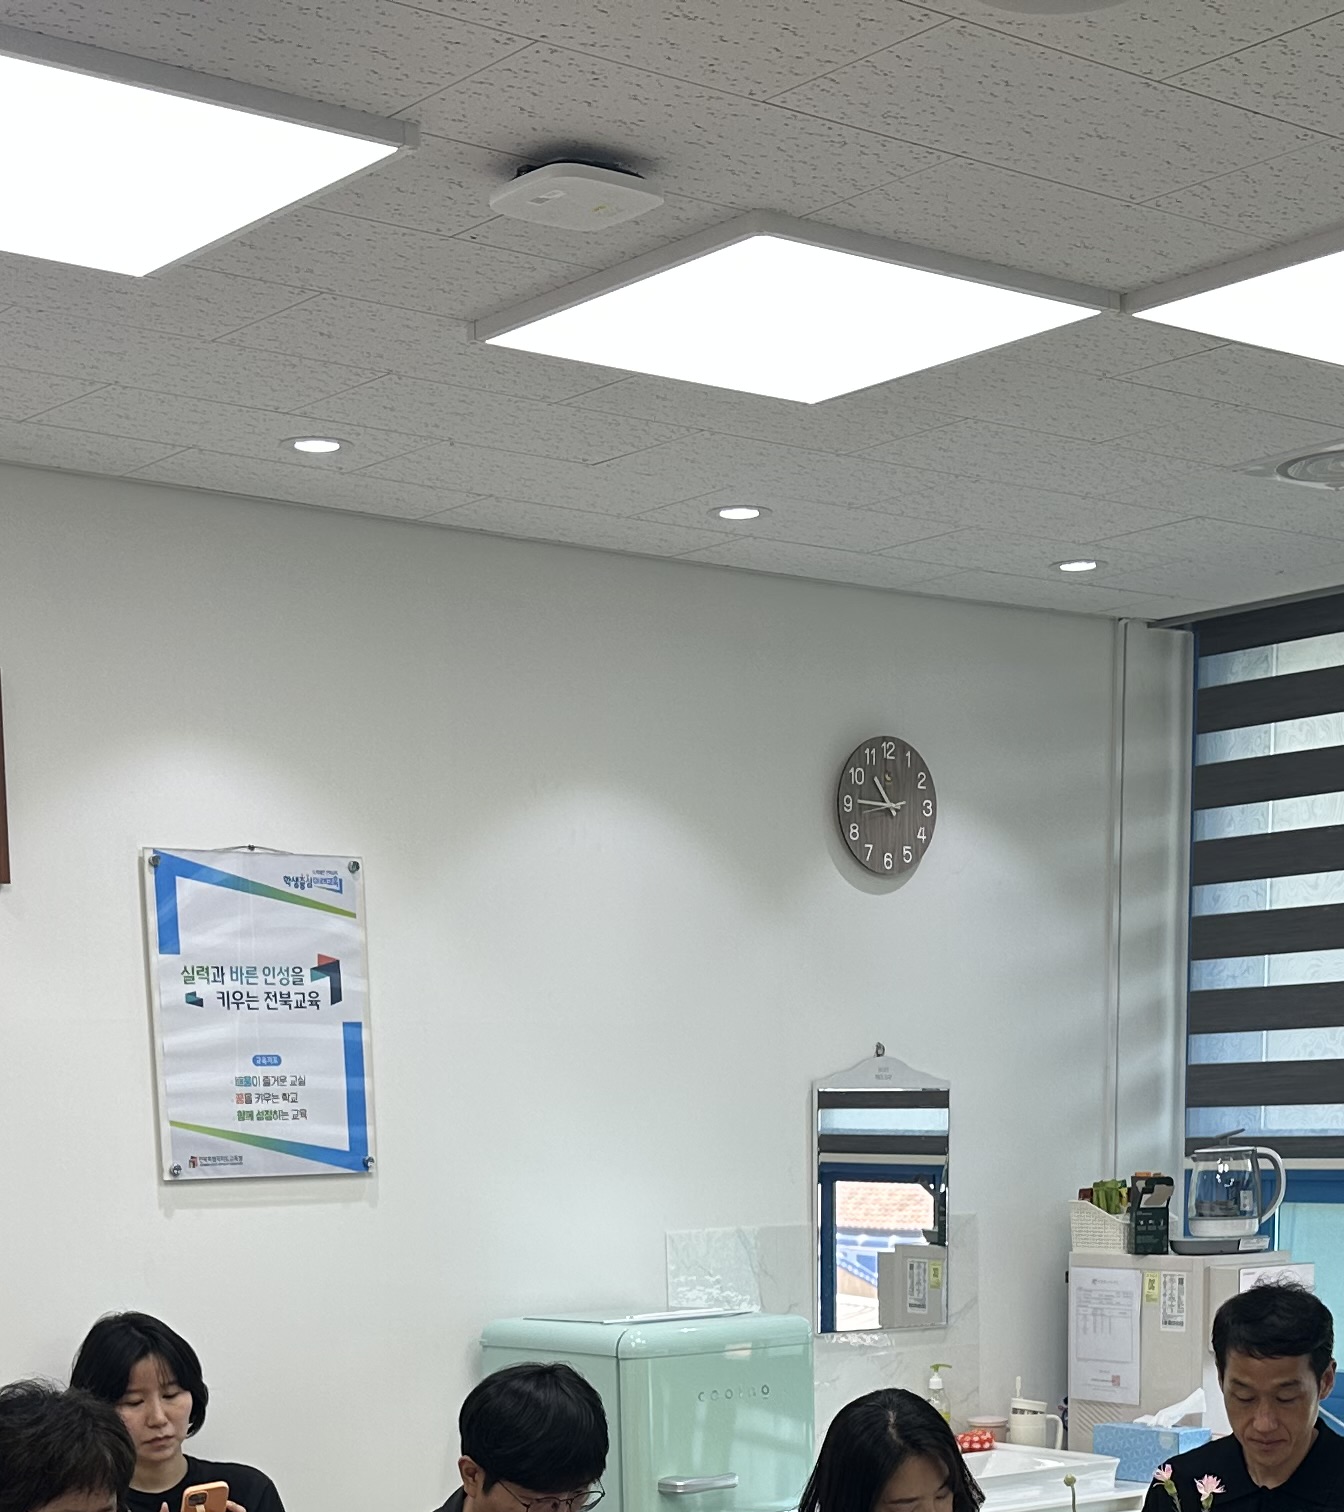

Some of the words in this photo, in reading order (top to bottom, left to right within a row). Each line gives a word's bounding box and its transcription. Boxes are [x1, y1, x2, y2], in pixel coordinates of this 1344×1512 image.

[864, 747, 876, 766] 11
[881, 741, 896, 760] 12
[905, 750, 912, 768] 1
[848, 766, 865, 785] 10
[917, 771, 927, 790] 2
[843, 794, 853, 812] 9
[922, 800, 933, 817] 3
[849, 823, 860, 841] 8
[917, 827, 927, 844] 4
[864, 844, 874, 861] 7
[883, 852, 893, 870] 6
[902, 845, 913, 863] 5
[180, 965, 225, 986] 실력과
[229, 965, 259, 986] 바른
[262, 965, 305, 987] 인성을
[216, 990, 260, 1011] 키우는
[264, 990, 322, 1011] 전북교육
[262, 1075, 288, 1087] 즐거운
[289, 1074, 306, 1087] 교실
[254, 1092, 281, 1105] 키우는
[281, 1092, 299, 1104] 학교
[291, 1108, 308, 1121] 교육
